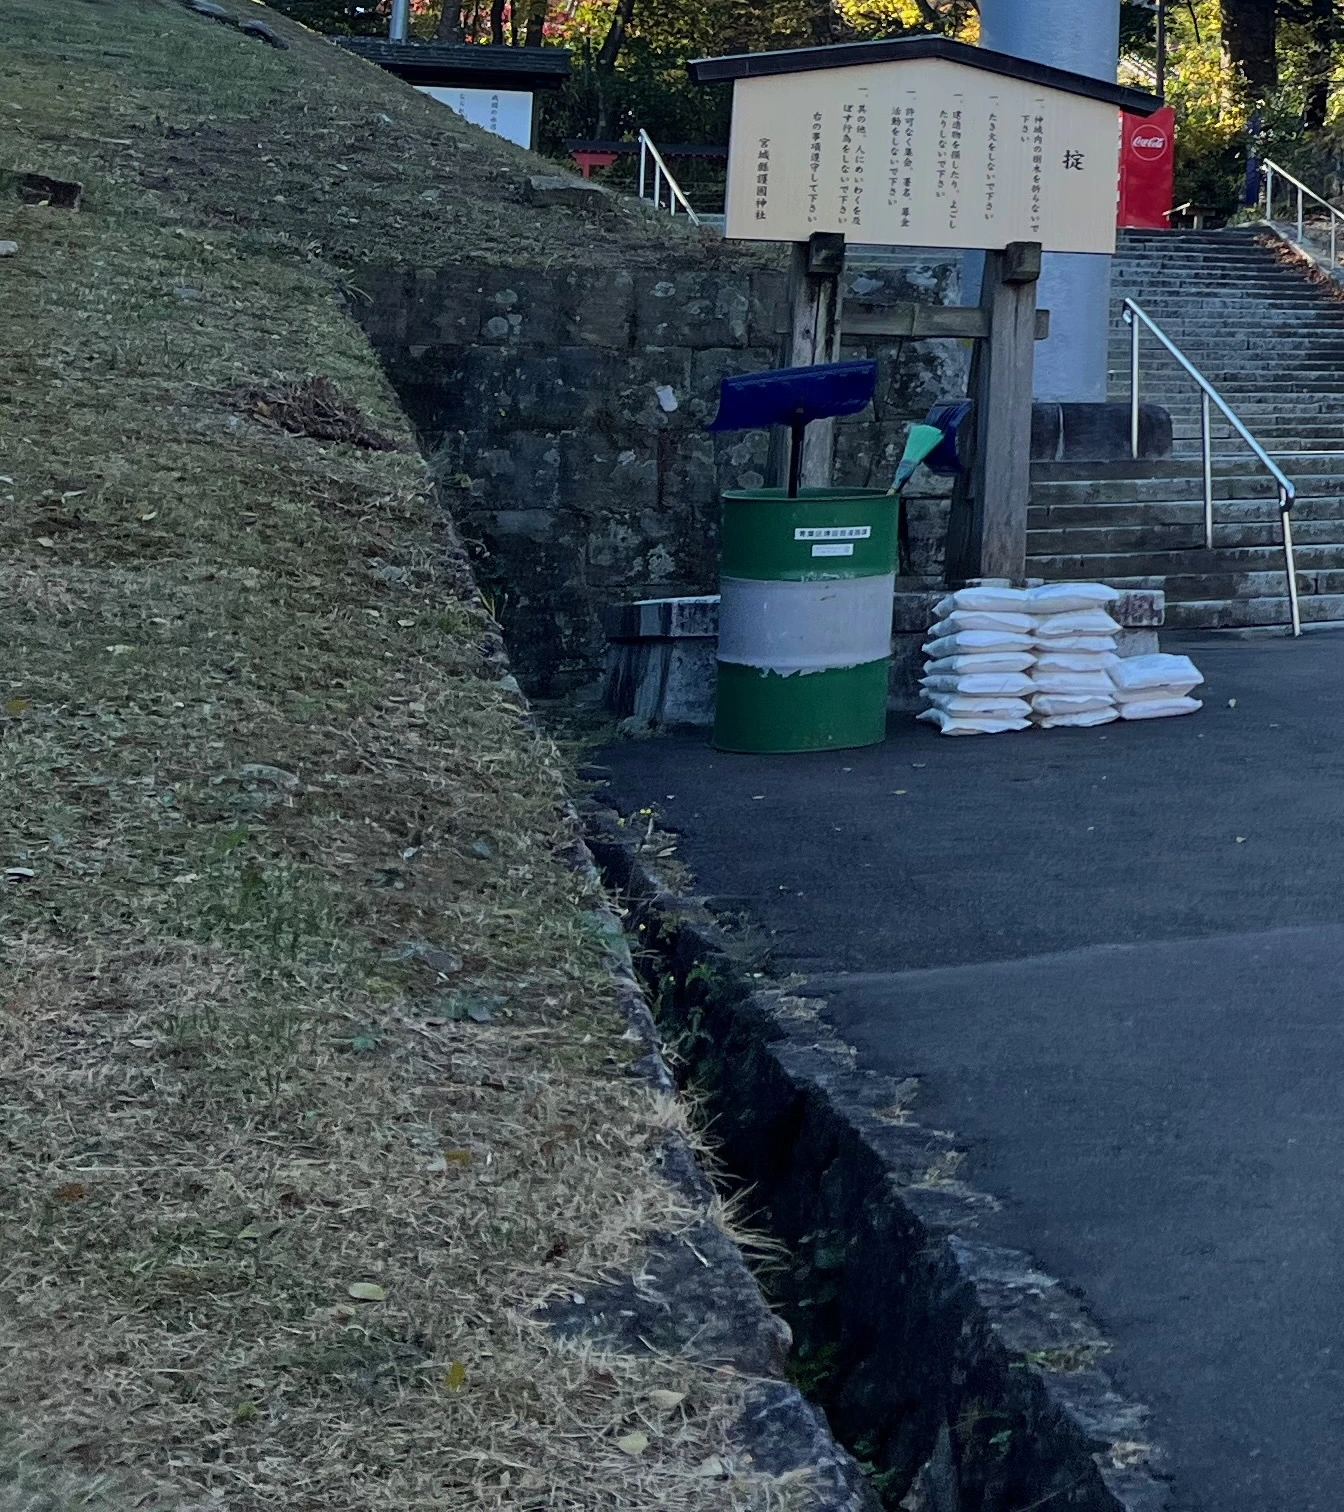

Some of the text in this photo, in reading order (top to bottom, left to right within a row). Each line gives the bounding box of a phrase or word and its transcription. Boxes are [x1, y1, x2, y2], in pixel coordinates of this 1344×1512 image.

[807, 111, 823, 224] 右の事項遵守して下さい
[838, 103, 854, 225] ぼす行為をしないで下さい
[887, 106, 901, 206] 活動をしないで下さい
[936, 109, 949, 198] たりしないで下さい
[1020, 114, 1031, 143] 下さい
[1062, 149, 1086, 171] 掟
